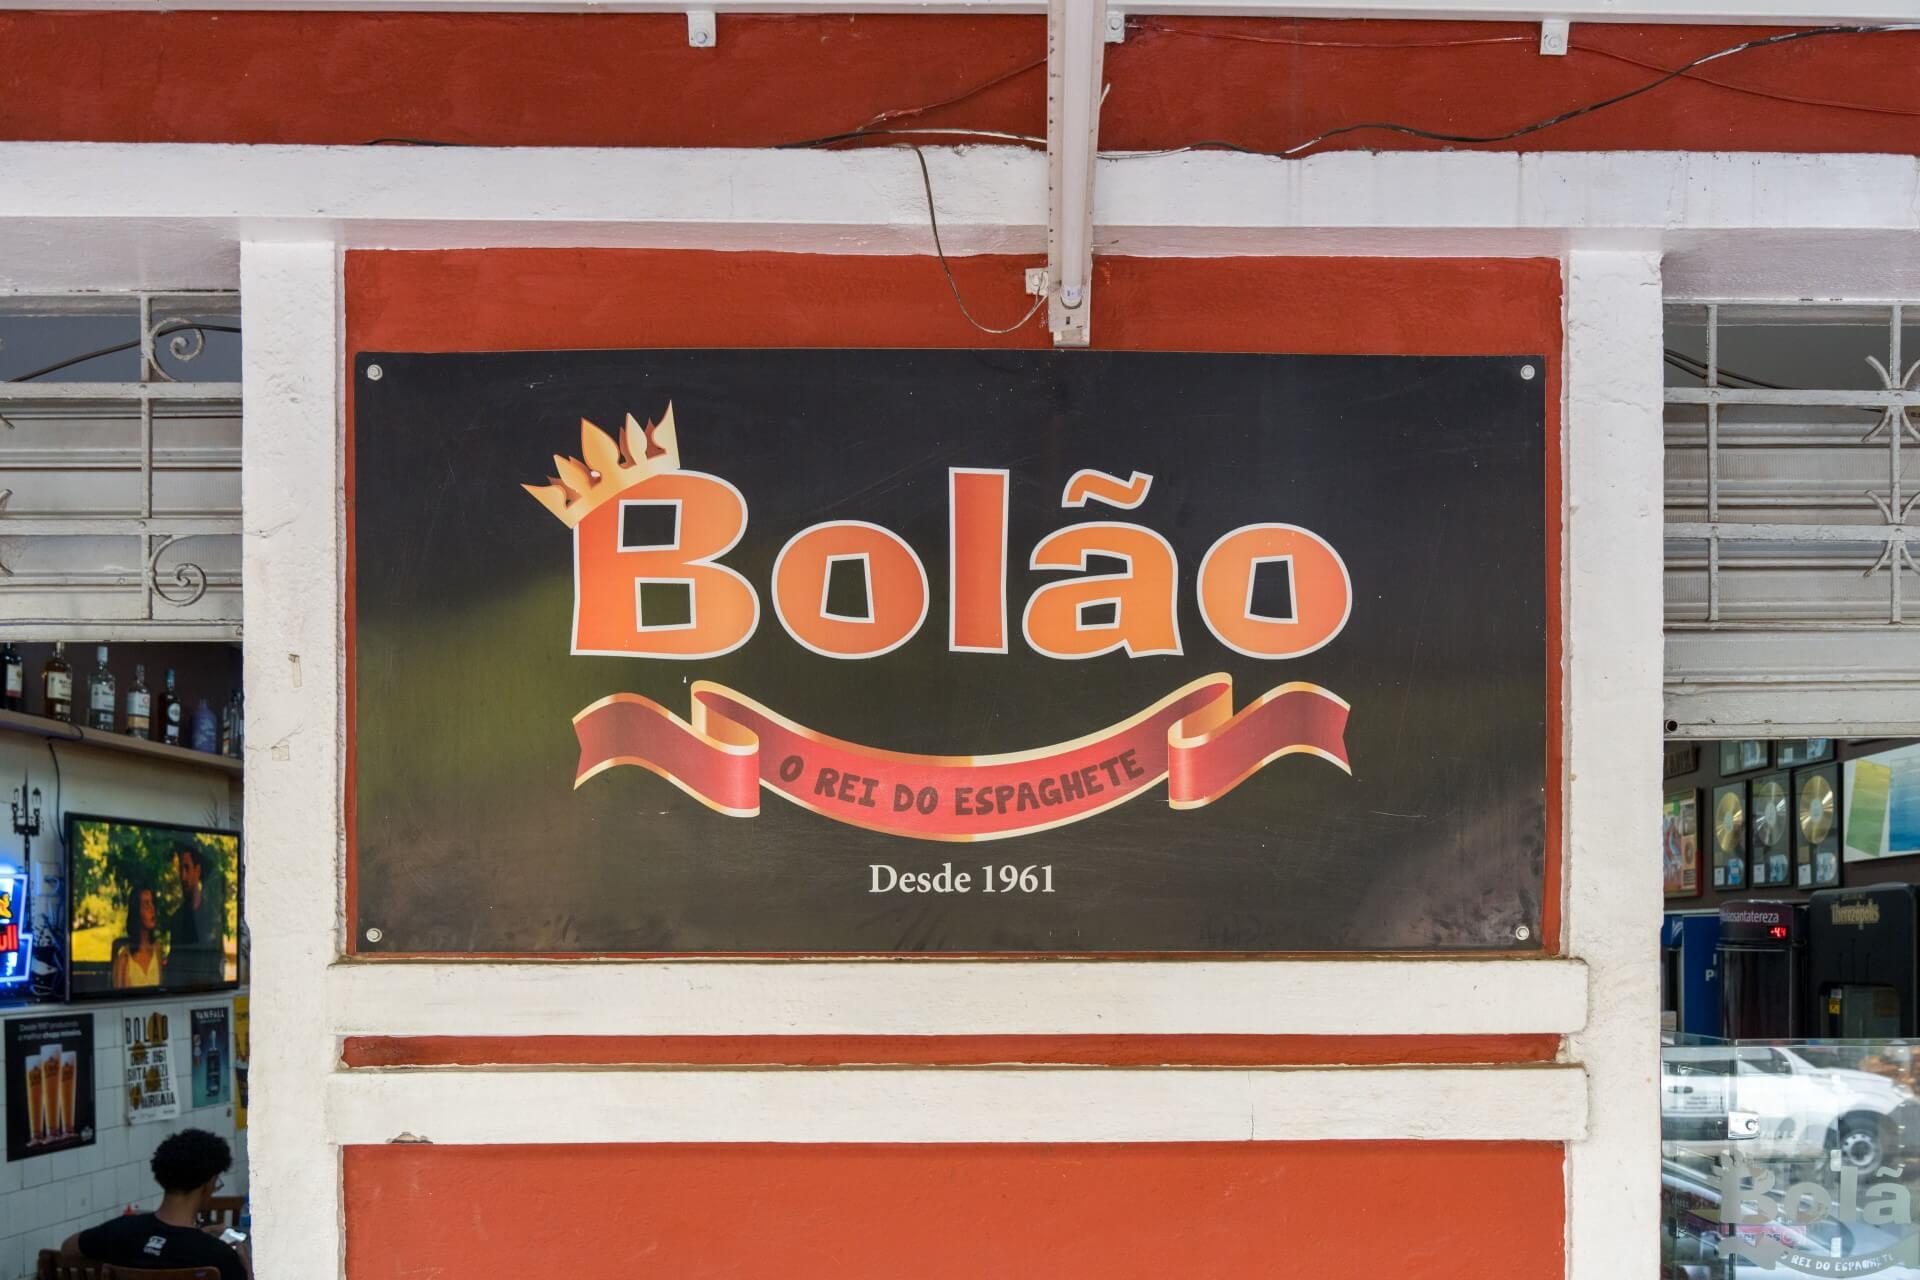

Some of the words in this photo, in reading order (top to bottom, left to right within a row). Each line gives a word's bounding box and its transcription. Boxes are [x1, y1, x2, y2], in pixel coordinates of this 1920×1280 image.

[570, 467, 1353, 660] Bolão
[779, 755, 804, 782] O
[814, 767, 880, 808] REI
[893, 783, 939, 815] DO
[955, 748, 1145, 816] ESPAGHETE
[868, 862, 971, 893] Desde
[982, 863, 1056, 893] 1961
[1790, 1254, 1812, 1268] REI
[1815, 1260, 1831, 1271] DO
